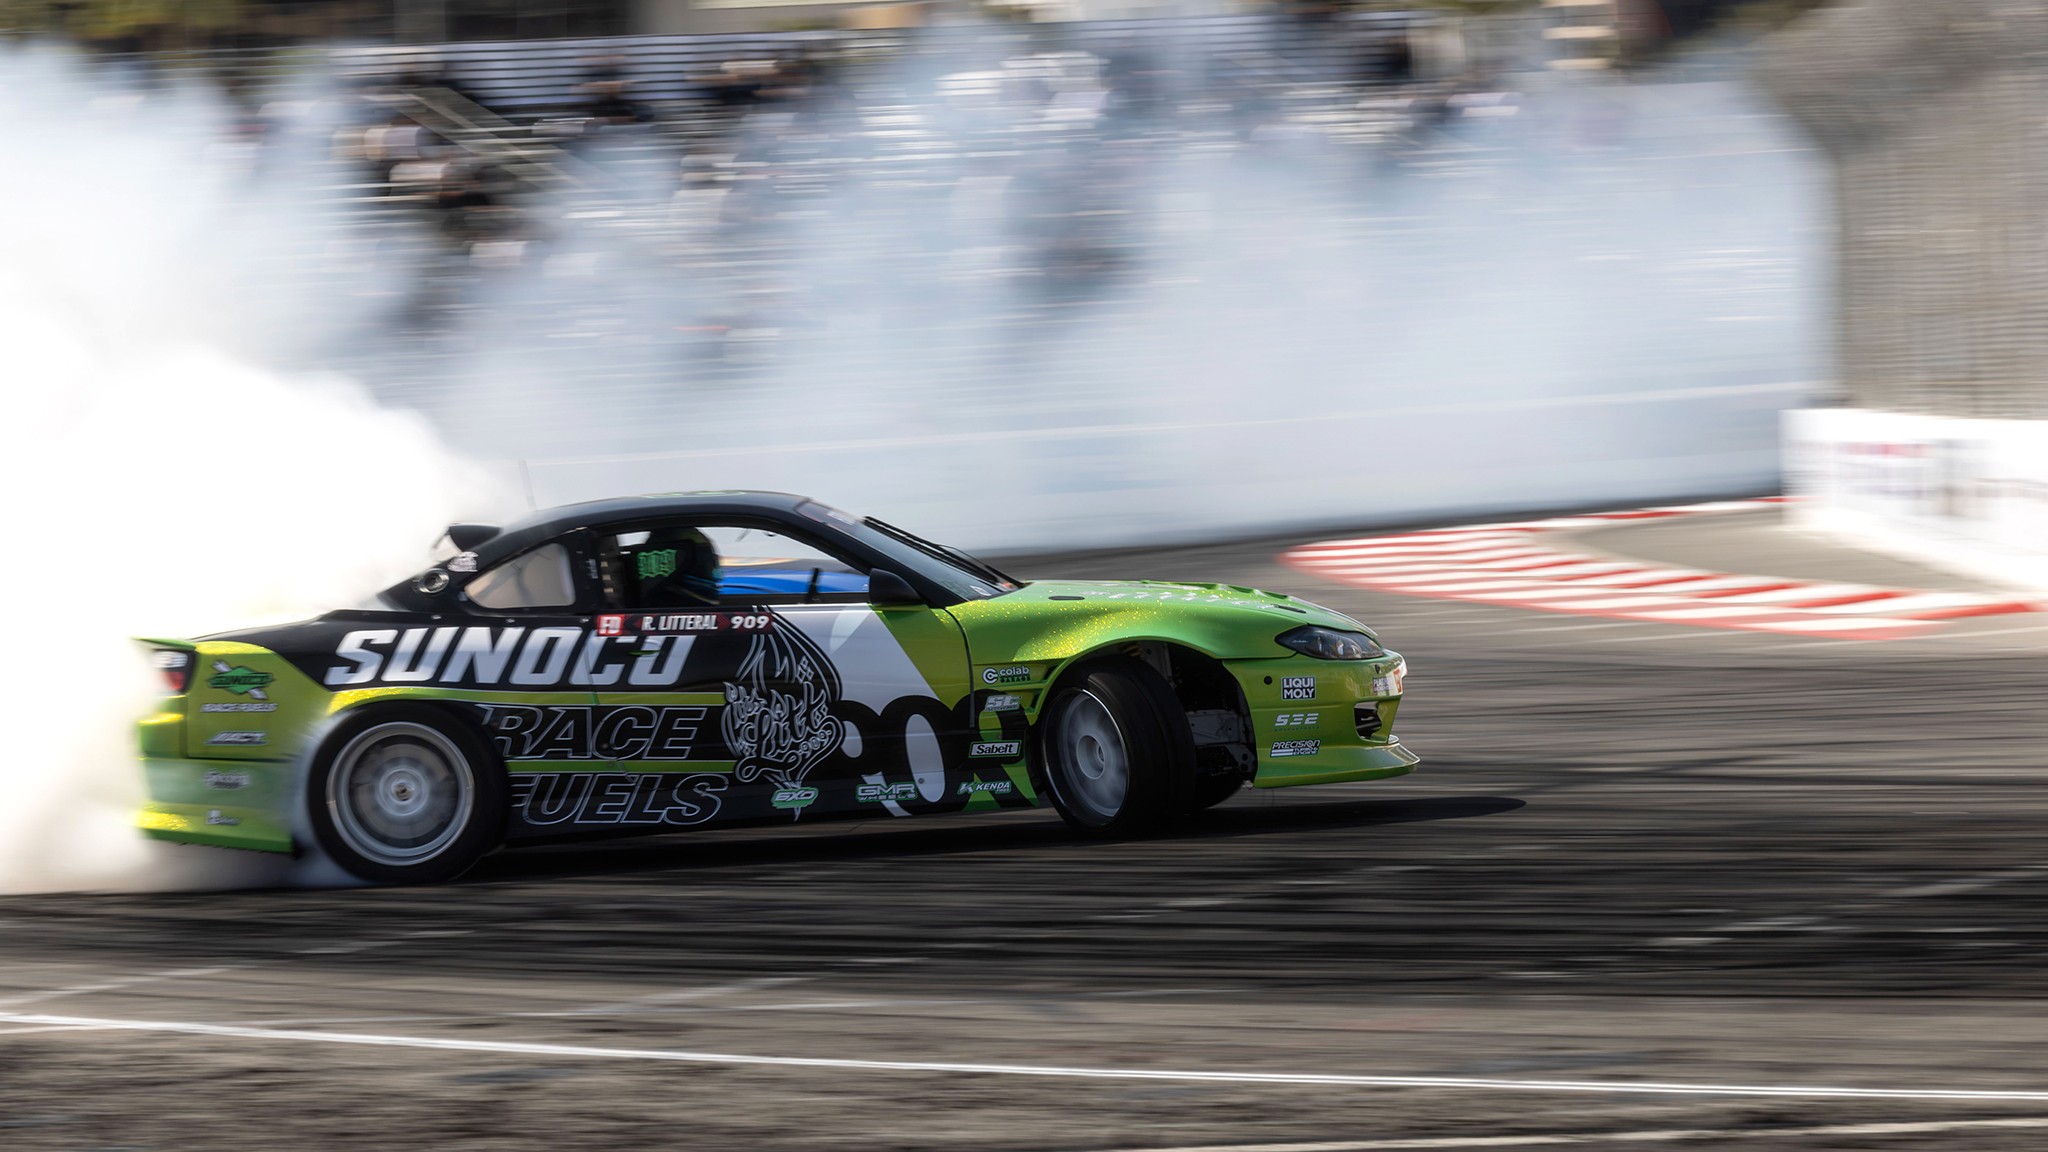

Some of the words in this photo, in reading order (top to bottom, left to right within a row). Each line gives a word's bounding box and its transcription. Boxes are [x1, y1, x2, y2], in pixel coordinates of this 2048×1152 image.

[641, 615, 656, 631] R.
[658, 615, 718, 631] LITTERAL
[730, 615, 769, 629] 909
[324, 626, 698, 685] SUNOCO
[1000, 665, 1030, 676] colab
[1283, 677, 1314, 688] LIQUI
[1283, 688, 1315, 699] MOLY
[475, 703, 708, 760] RACE
[976, 743, 1013, 754] Sabelt
[1272, 740, 1320, 750] PRECISION
[858, 784, 915, 796] GMR
[976, 782, 1010, 791] KENDA
